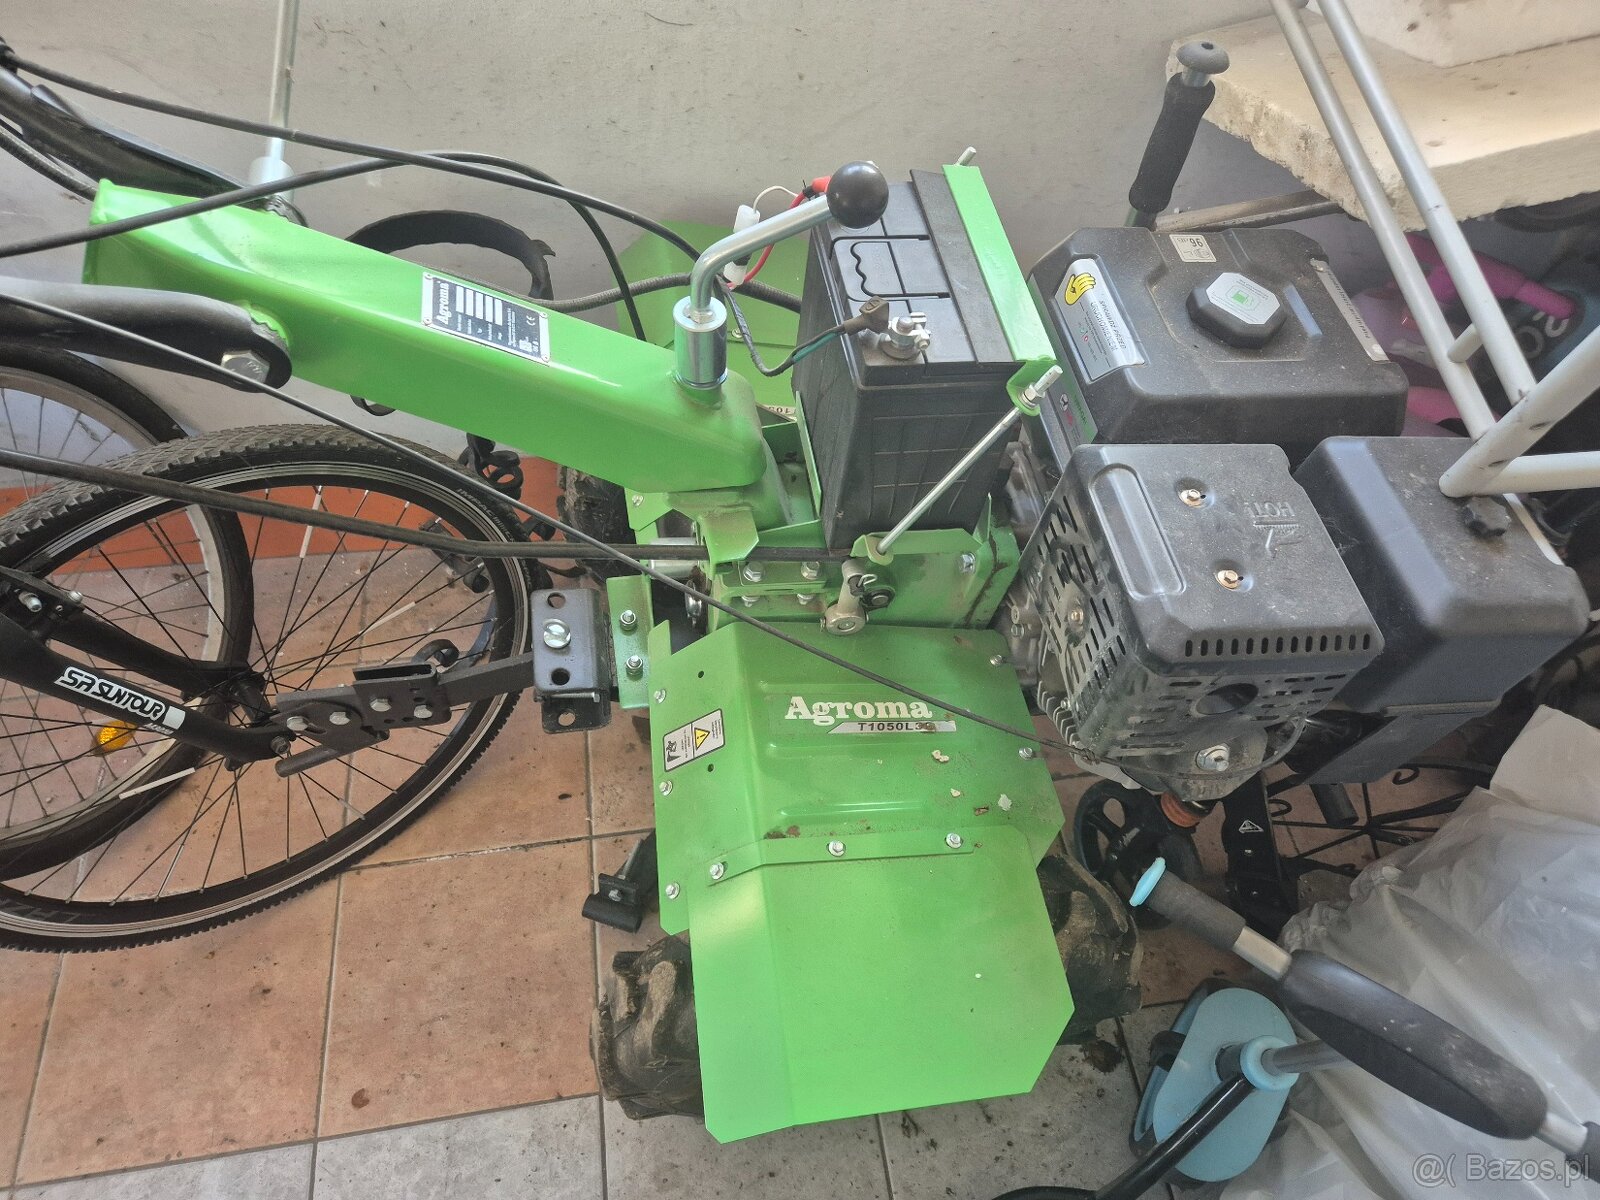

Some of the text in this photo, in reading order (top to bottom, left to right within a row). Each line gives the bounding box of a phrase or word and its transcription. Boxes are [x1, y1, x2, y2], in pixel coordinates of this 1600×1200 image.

[436, 282, 452, 325] Agroma
[91, 681, 164, 717] SUNTOUR
[785, 696, 933, 727] Agroma
